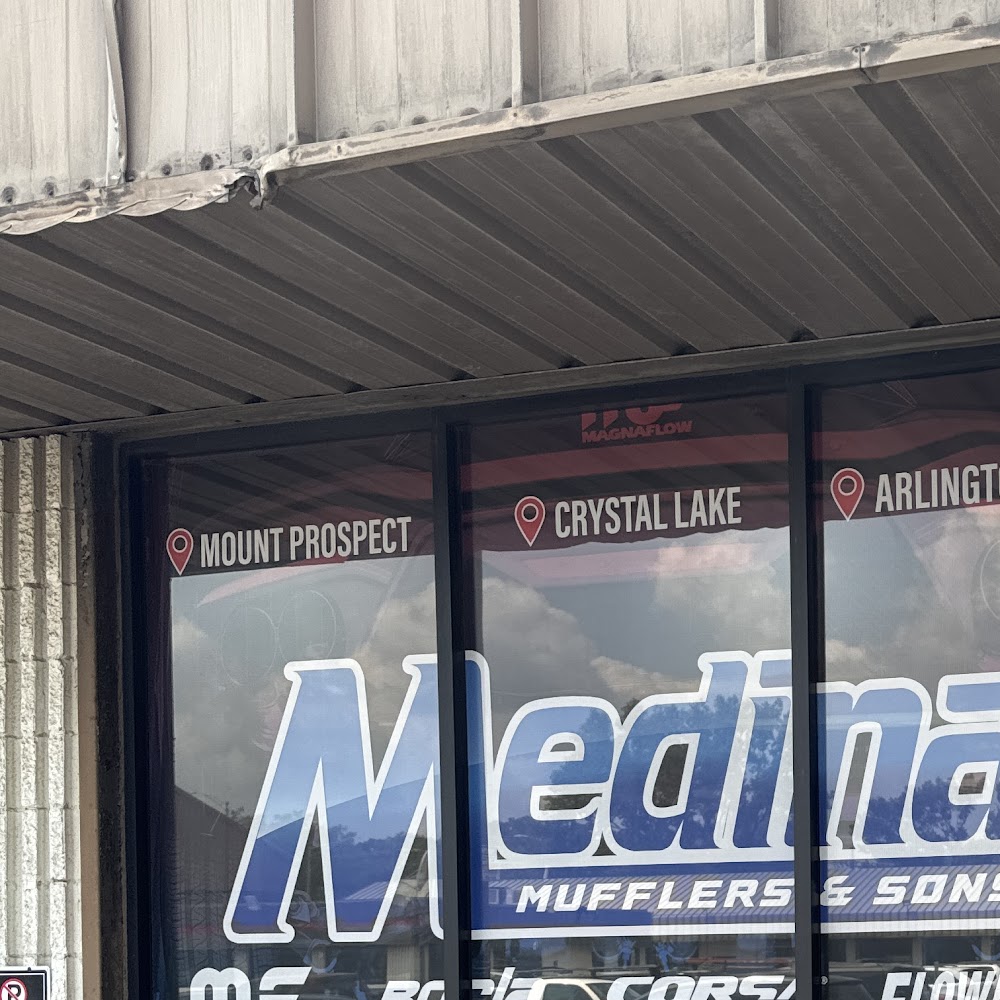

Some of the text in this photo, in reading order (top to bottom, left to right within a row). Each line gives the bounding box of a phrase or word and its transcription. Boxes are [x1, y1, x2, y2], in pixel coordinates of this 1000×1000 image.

[582, 420, 692, 443] MAGNAFLOW
[554, 486, 742, 539] CRYSTAL LAKE
[200, 516, 412, 568] MOUNT PROSPECT
[515, 878, 795, 913] MUFFLERS
[820, 875, 855, 906] &
